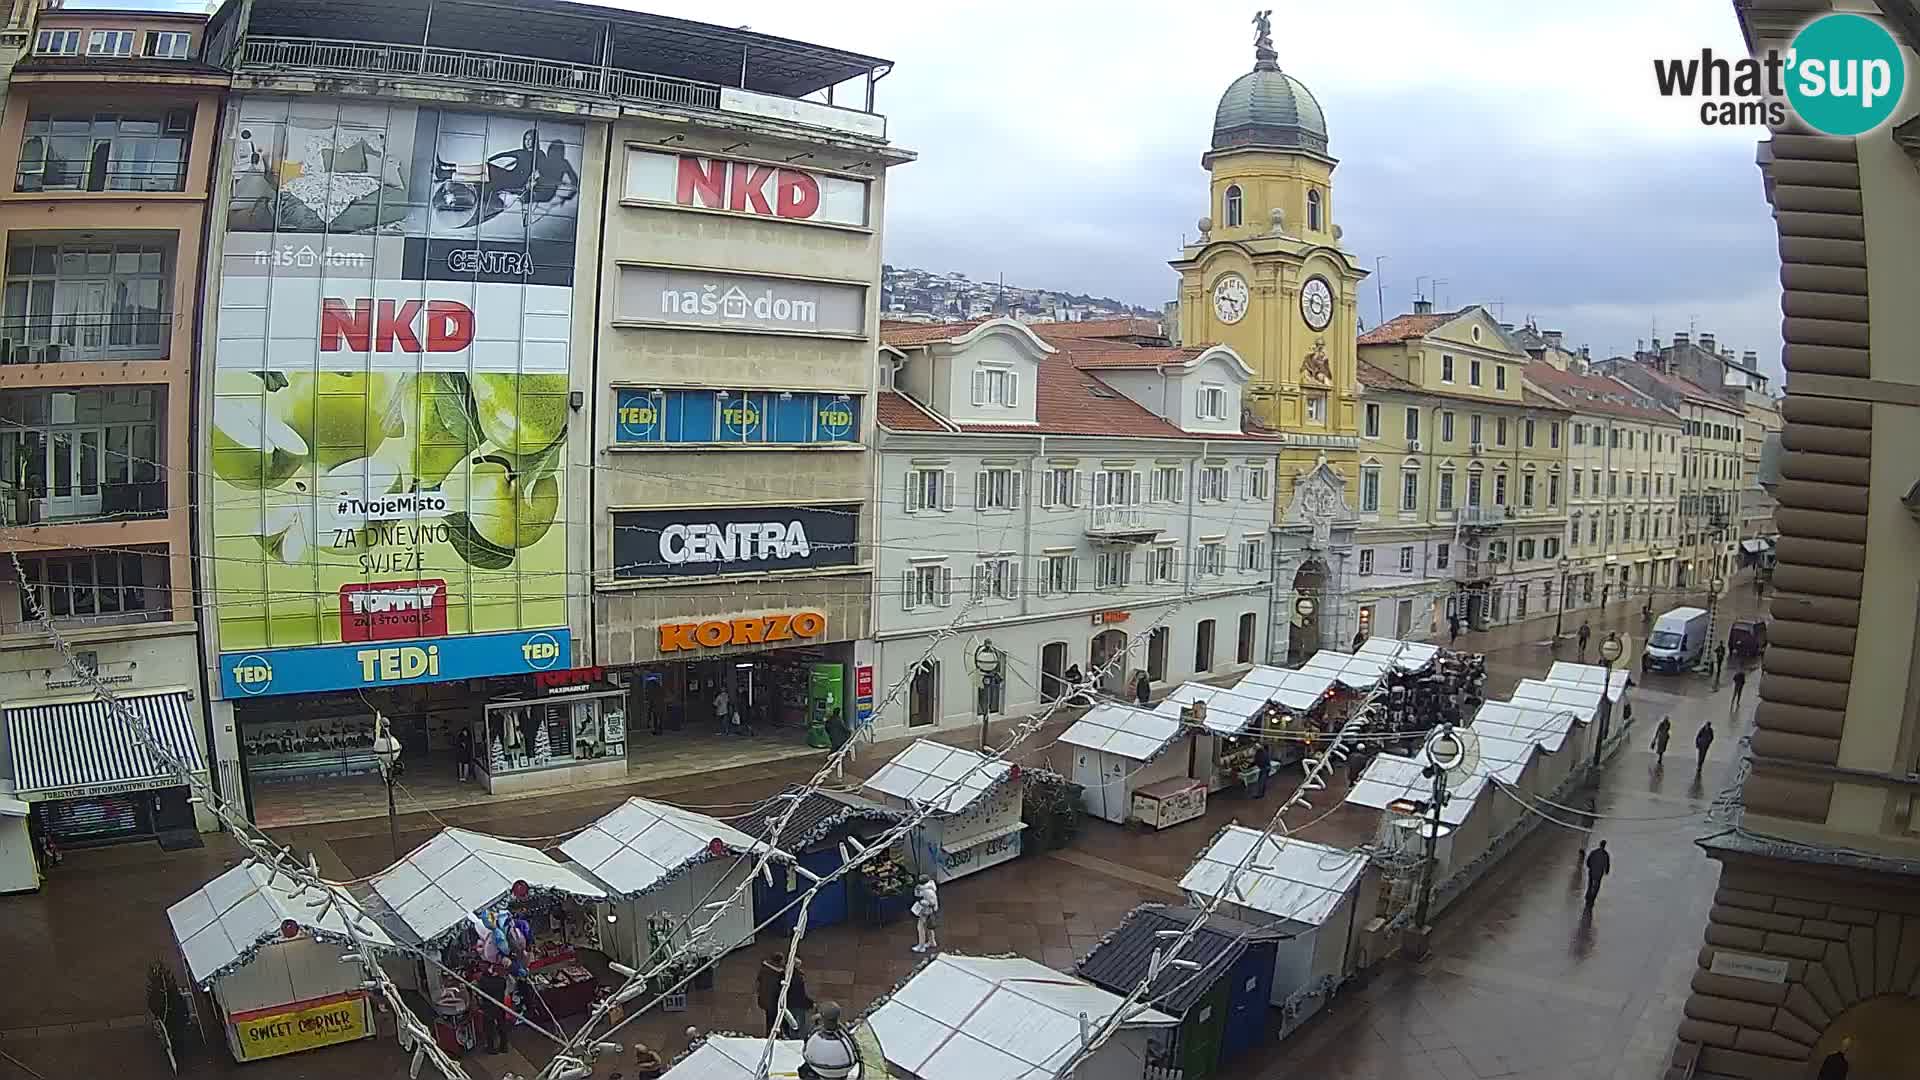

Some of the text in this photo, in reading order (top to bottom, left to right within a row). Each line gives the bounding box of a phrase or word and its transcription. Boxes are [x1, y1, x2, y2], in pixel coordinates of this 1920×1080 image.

[677, 158, 820, 219] NKD
[253, 245, 366, 269] naš dom
[447, 249, 535, 275] CENTRA
[661, 284, 817, 323] naš dom
[320, 297, 476, 353] NKD
[618, 407, 658, 424] TEDi
[723, 408, 760, 425] TEDi
[819, 410, 853, 426] TEDi
[337, 497, 446, 516] #TvojeMisto
[333, 523, 450, 548] ZA DNEVNO
[659, 520, 811, 564] CENTRA
[358, 547, 425, 575] SVJEŽE
[348, 585, 438, 614] TOMMY
[659, 612, 825, 652] KORZO
[357, 645, 440, 682] TEDi
[521, 643, 560, 660] TEDi
[232, 665, 273, 684] TEDi
[549, 684, 592, 695] MAXIMARKET
[249, 1021, 292, 1042] SWEET
[298, 1010, 351, 1033] CORNER
